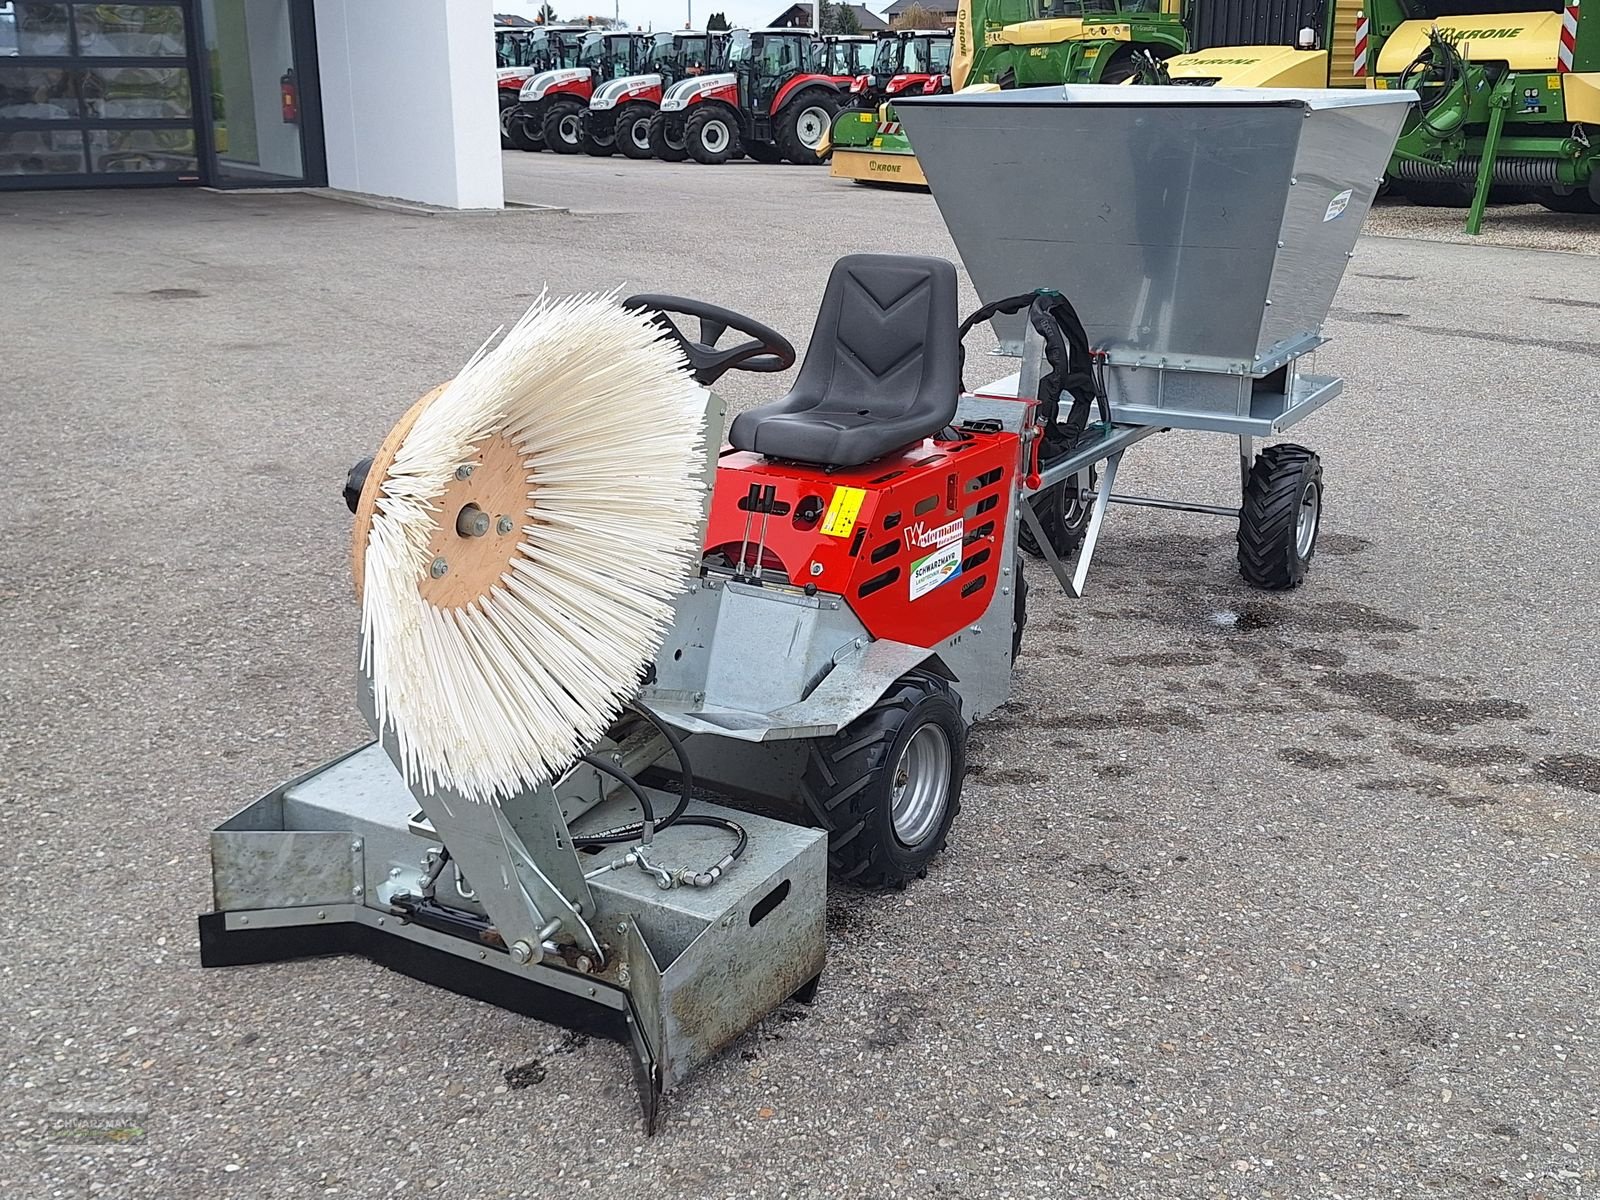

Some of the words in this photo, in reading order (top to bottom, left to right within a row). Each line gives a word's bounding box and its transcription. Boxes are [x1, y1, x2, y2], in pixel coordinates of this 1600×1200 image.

[959, 21, 967, 56] KRONE
[1454, 28, 1524, 39] KRONE
[1192, 58, 1260, 66] KRONE
[877, 163, 902, 172] KRONE
[904, 521, 962, 551] Westermann
[915, 549, 955, 578] SCHWARZMAYR
